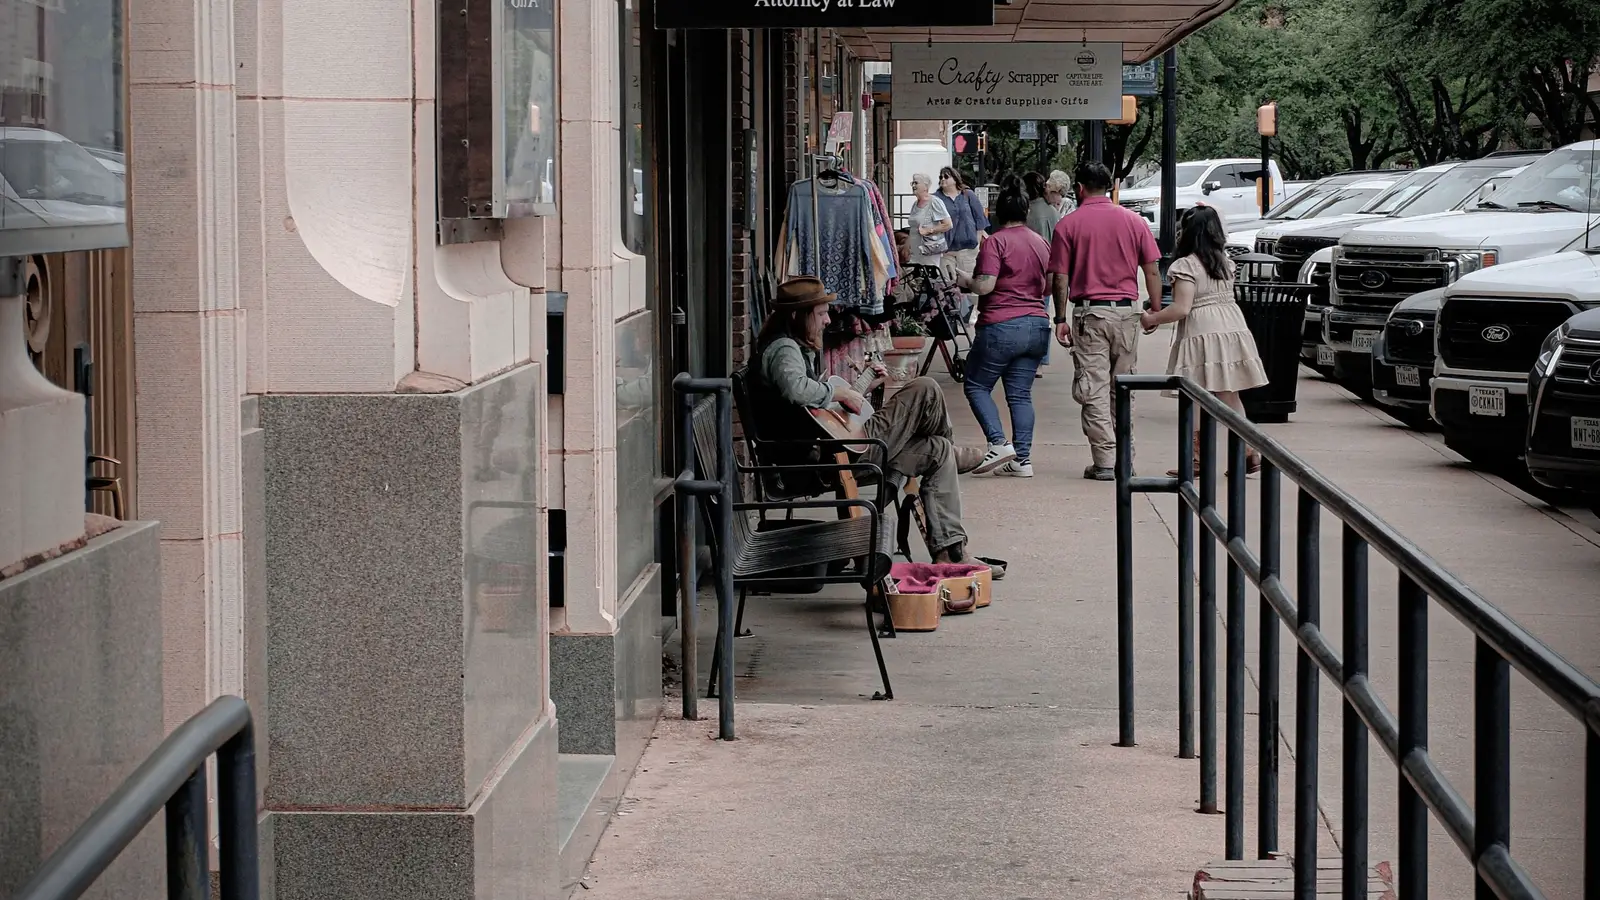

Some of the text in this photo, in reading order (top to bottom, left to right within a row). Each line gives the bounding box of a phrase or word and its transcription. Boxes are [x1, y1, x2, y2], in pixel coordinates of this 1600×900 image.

[754, 0, 829, 12] Attorney
[912, 57, 1059, 94] The Crafty Scrapper
[926, 97, 1089, 107] Arts & Crafts Supplies Gifts
[1486, 328, 1505, 340] Ford
[1583, 419, 1599, 427] TEXAS
